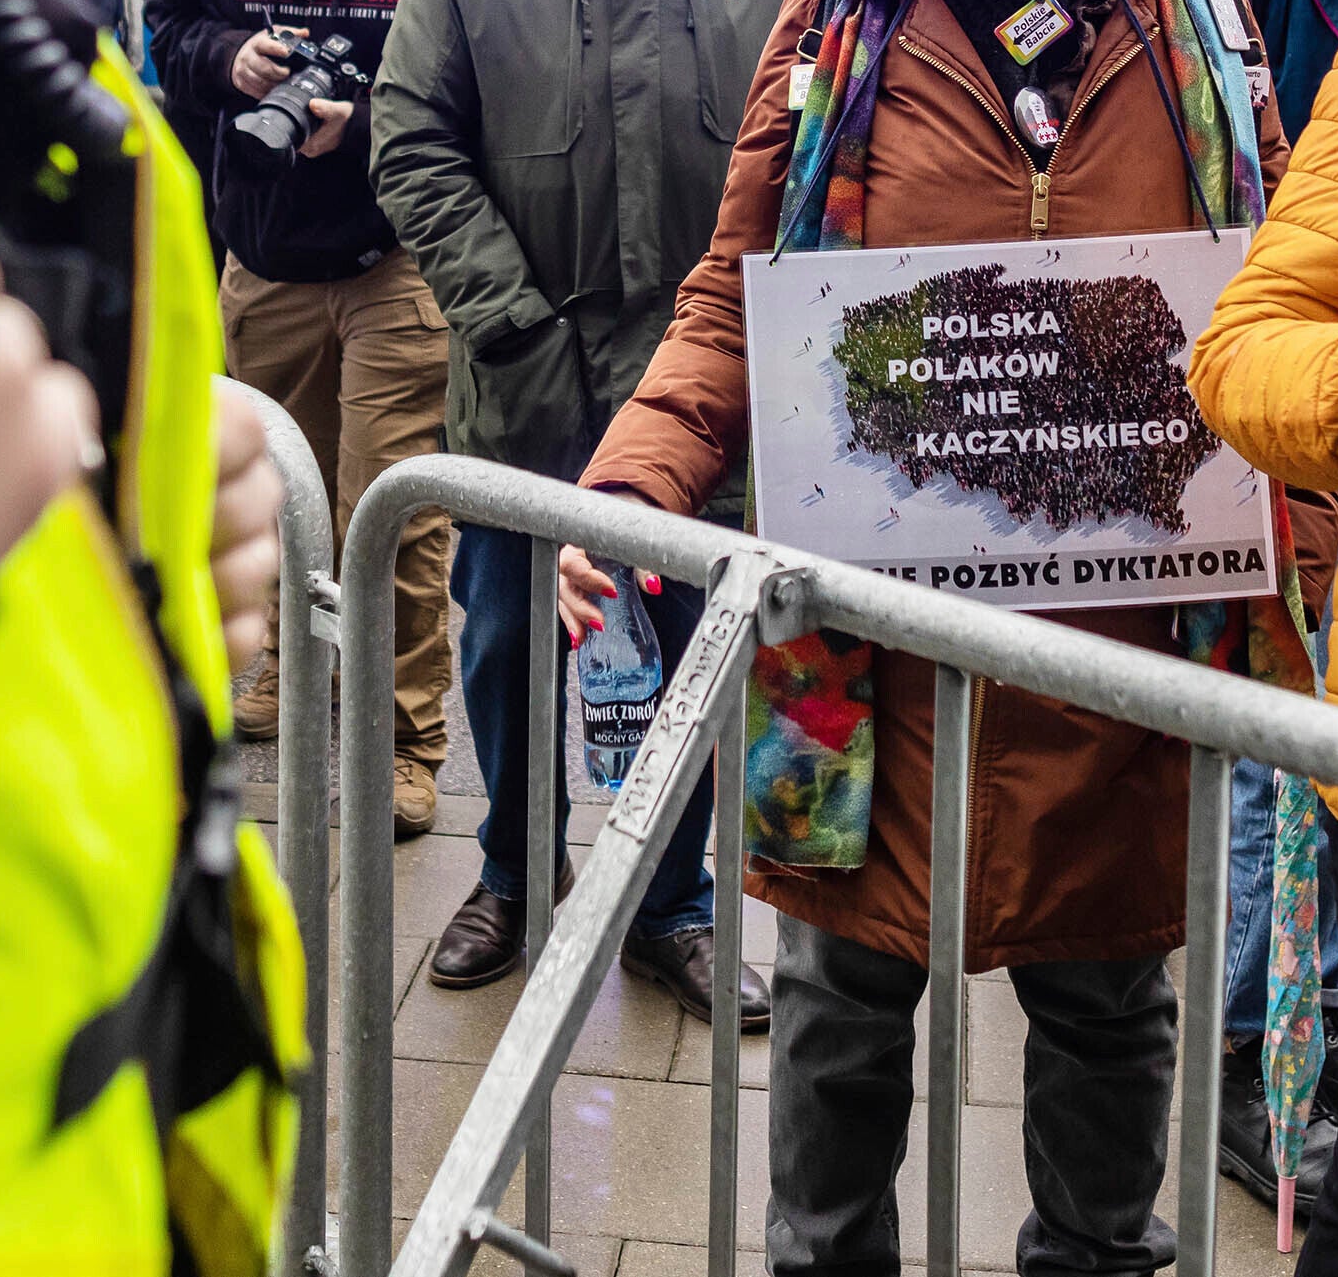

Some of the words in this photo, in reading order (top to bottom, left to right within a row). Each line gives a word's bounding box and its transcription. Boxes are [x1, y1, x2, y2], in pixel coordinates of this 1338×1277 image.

[1013, 6, 1046, 35] Polskie
[1025, 21, 1056, 49] Babcie
[922, 310, 1062, 340] POLSKA
[888, 350, 1060, 383] POLAKÓW
[963, 390, 1020, 416] NIE
[916, 419, 1190, 457] KACZYŃSKIEGO
[931, 553, 1060, 590] POZBYĆ
[1073, 547, 1266, 584] DYKTATORA
[595, 732, 627, 743] MOCNY
